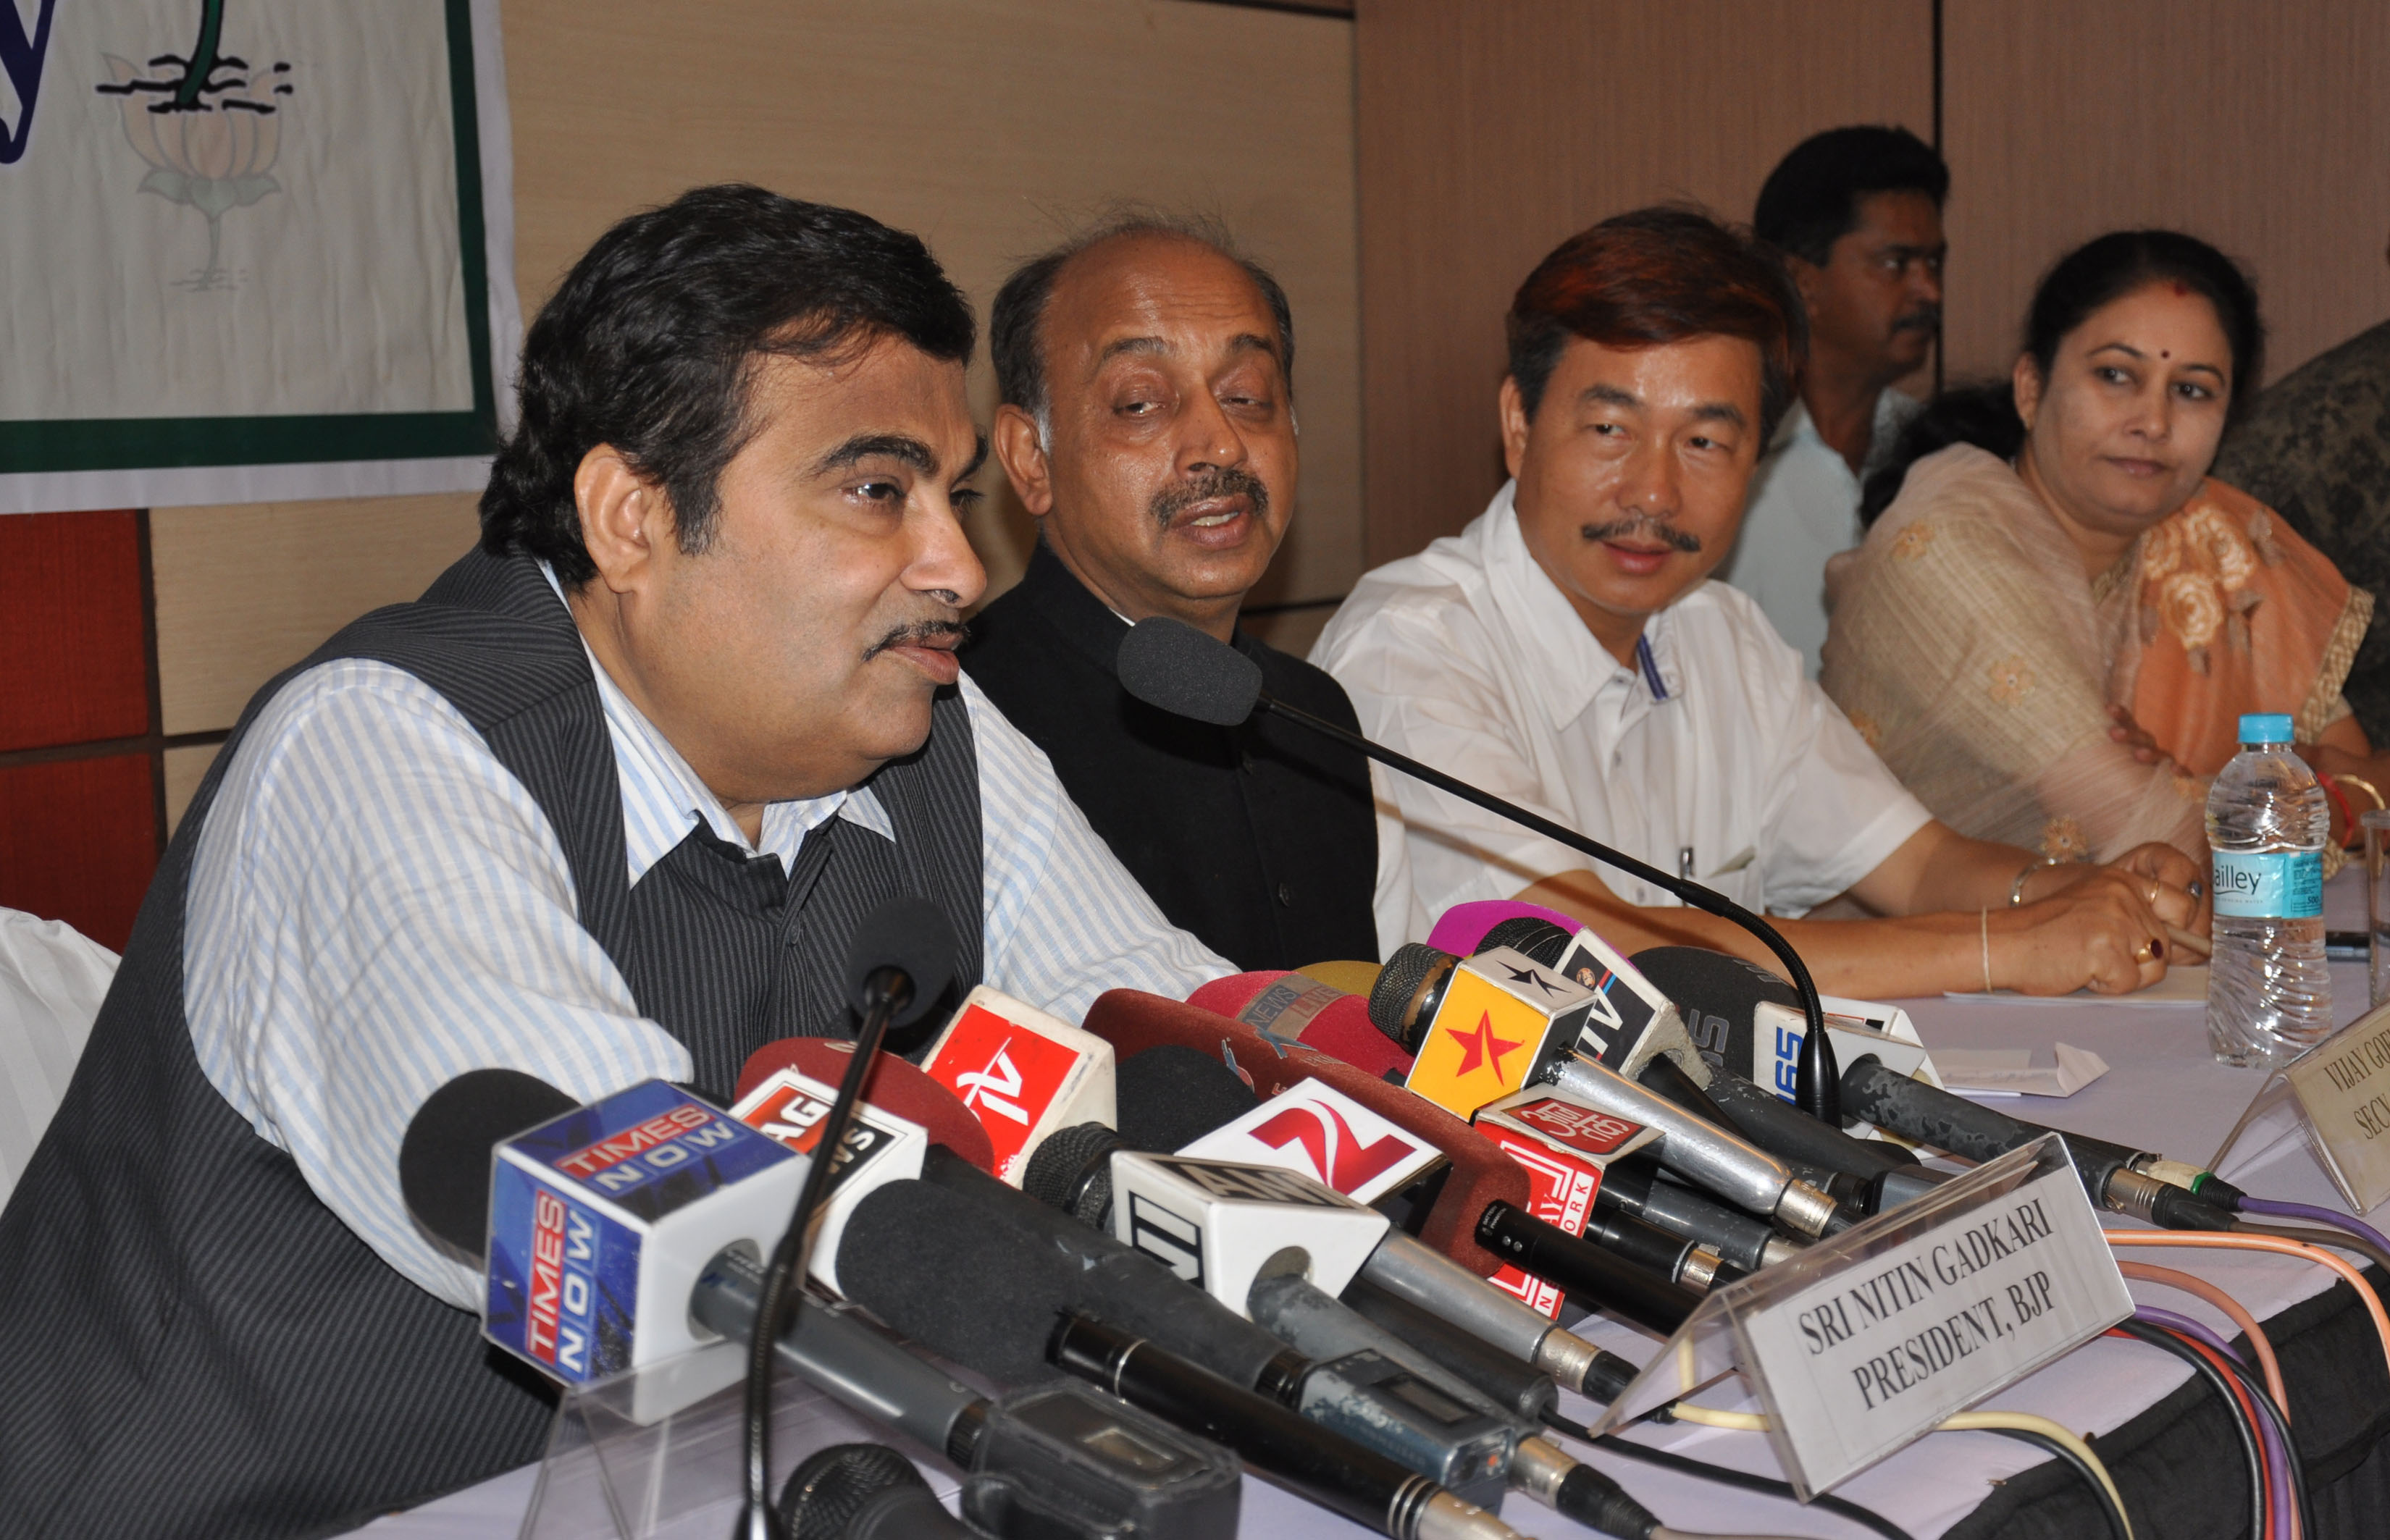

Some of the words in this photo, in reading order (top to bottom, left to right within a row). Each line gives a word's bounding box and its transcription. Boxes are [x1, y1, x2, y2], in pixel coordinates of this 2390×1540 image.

[2214, 865, 2261, 895] ailley
[1245, 988, 1297, 1024] NEWS
[1288, 986, 1341, 1019] LIVE
[2323, 1046, 2373, 1093] VIJAY
[2364, 1028, 2390, 1069] GOE
[556, 1105, 712, 1176] TIMES
[760, 1096, 833, 1142] AG
[596, 1122, 735, 1191] NOW
[529, 1194, 565, 1357] TIMES
[1540, 1184, 1589, 1310] NEORK
[1798, 1298, 1856, 1358] SRI
[1849, 1254, 1935, 1329] NITIN
[1931, 1198, 2055, 1287] GADKARI
[559, 1210, 594, 1373] NOW
[1850, 1297, 2016, 1411] PRESIDENT,
[2005, 1270, 2057, 1324] BJP
